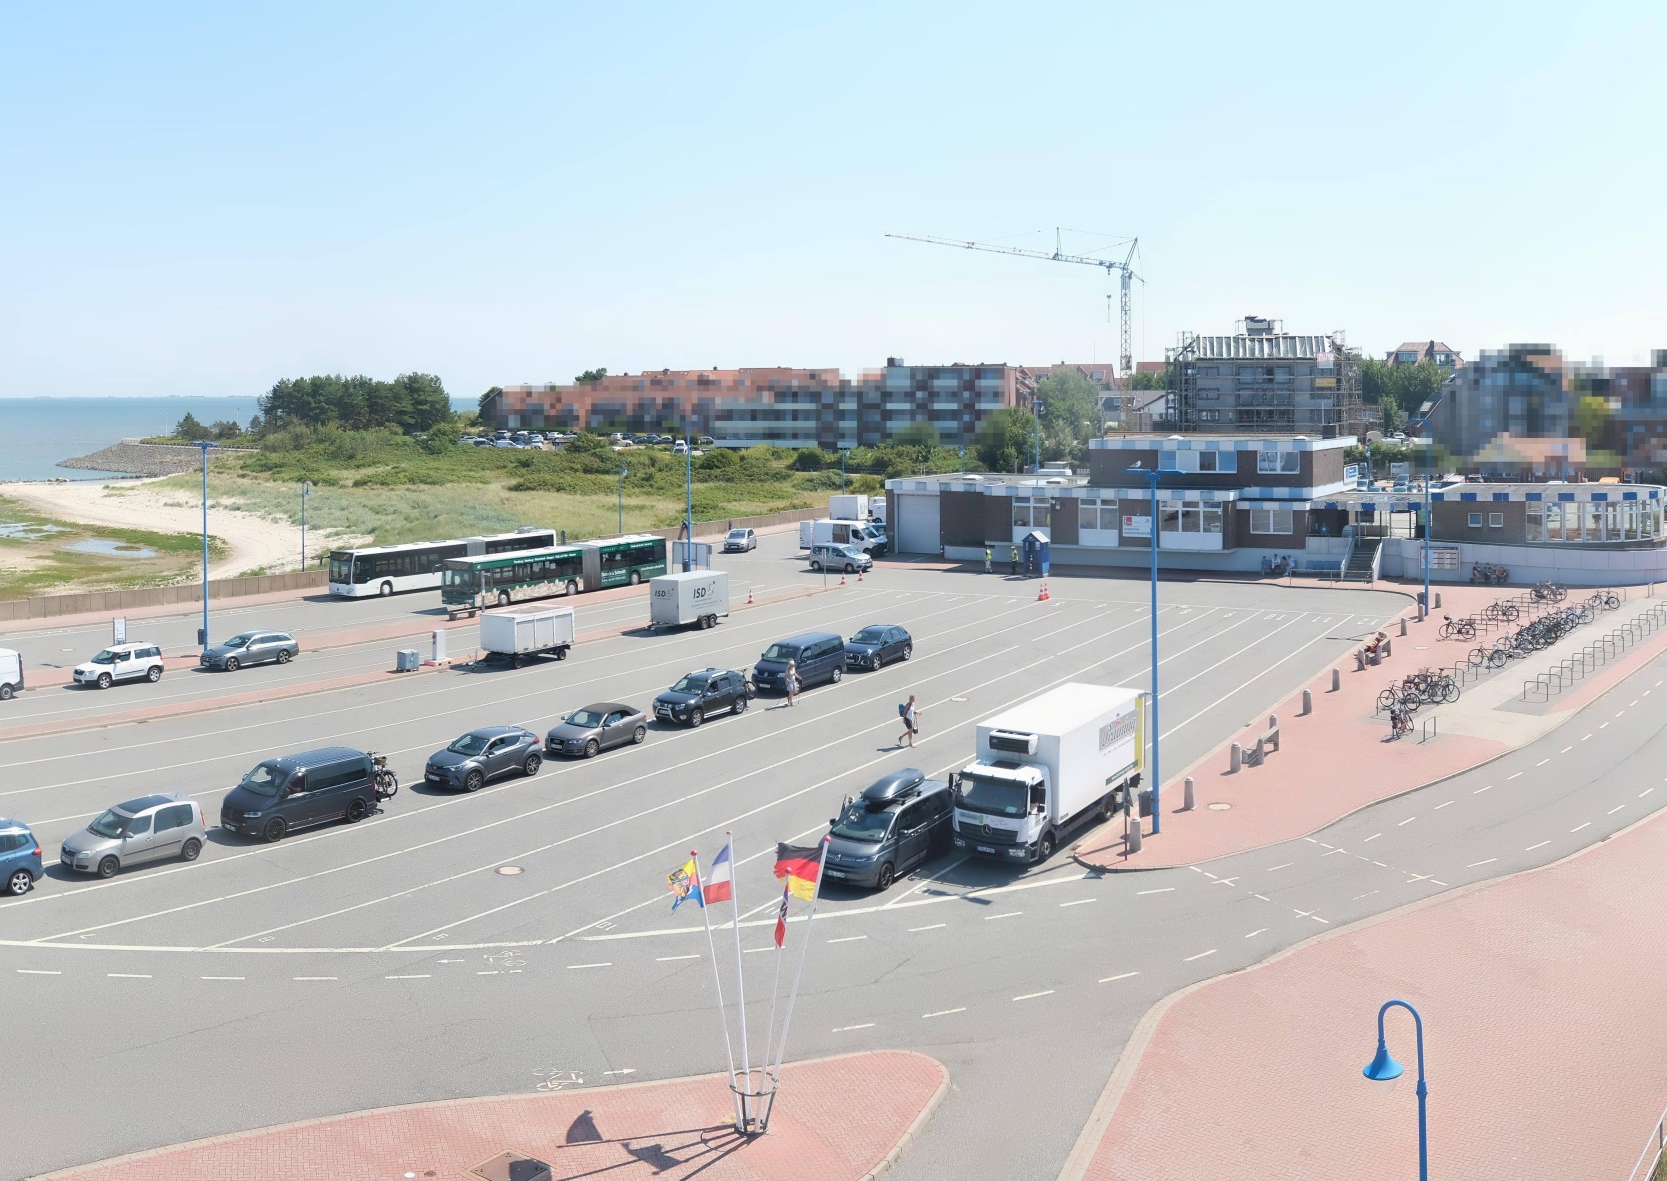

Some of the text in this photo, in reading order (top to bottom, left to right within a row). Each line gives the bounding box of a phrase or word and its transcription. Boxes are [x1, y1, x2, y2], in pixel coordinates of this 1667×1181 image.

[693, 587, 707, 599] ISD
[1263, 613, 1287, 621] 10
[596, 921, 617, 931] 10
